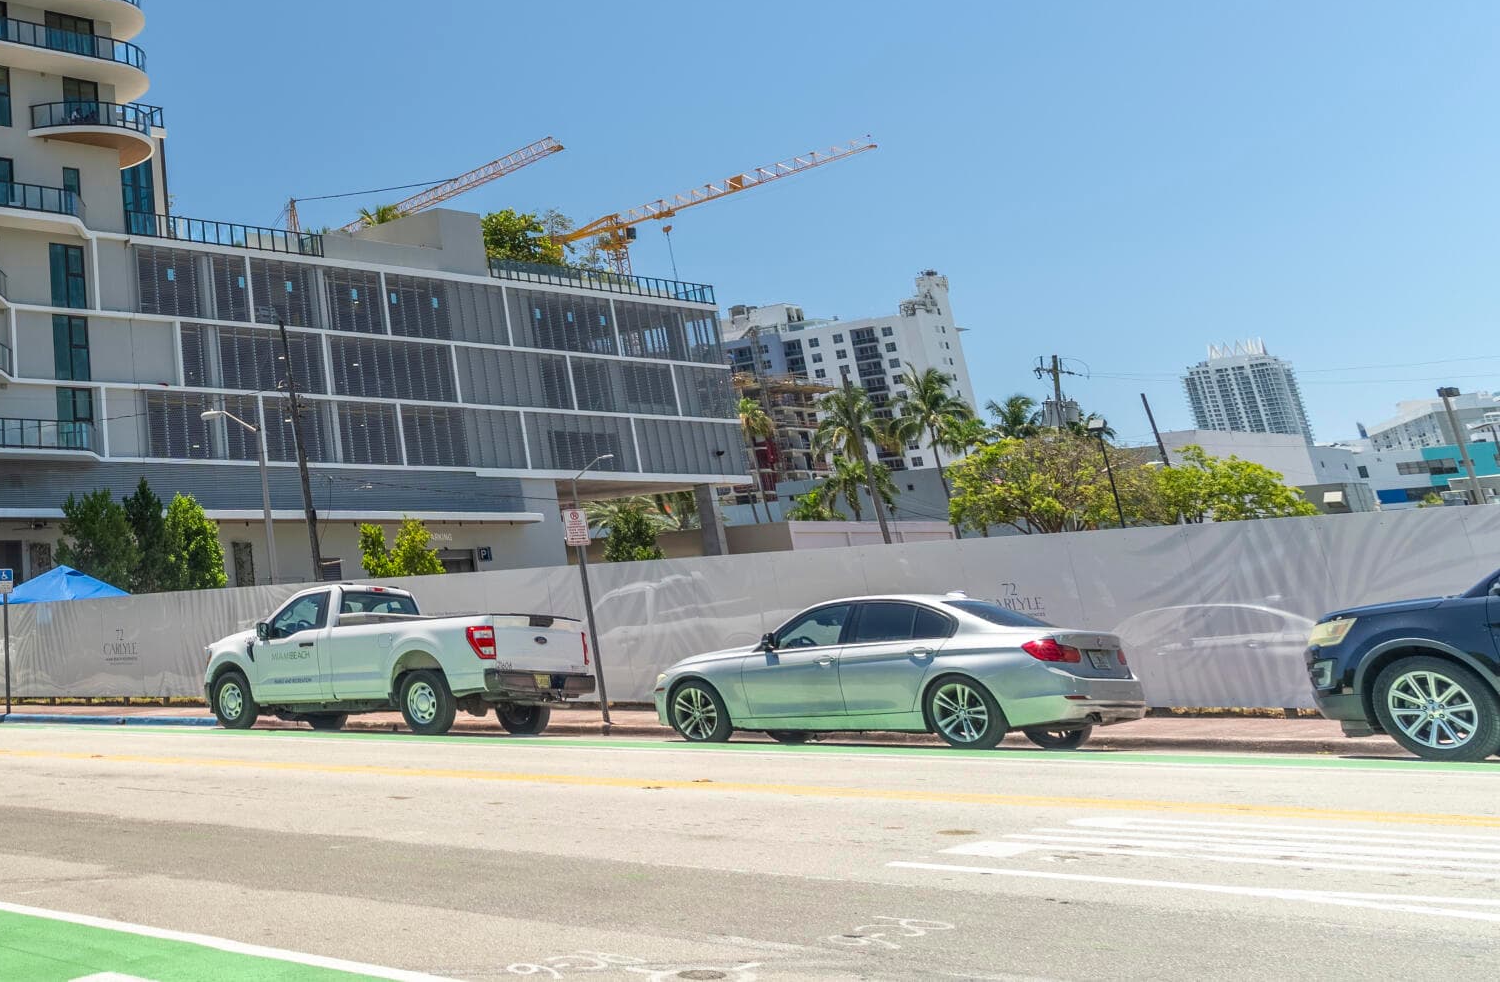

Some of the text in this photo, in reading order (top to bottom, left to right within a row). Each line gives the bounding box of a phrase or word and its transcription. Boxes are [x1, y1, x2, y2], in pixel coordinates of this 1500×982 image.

[430, 532, 453, 541] ARKING
[1001, 582, 1018, 596] 72
[995, 597, 1045, 611] ARLYLE
[115, 628, 125, 641] 72
[103, 642, 138, 656] CARLYLE
